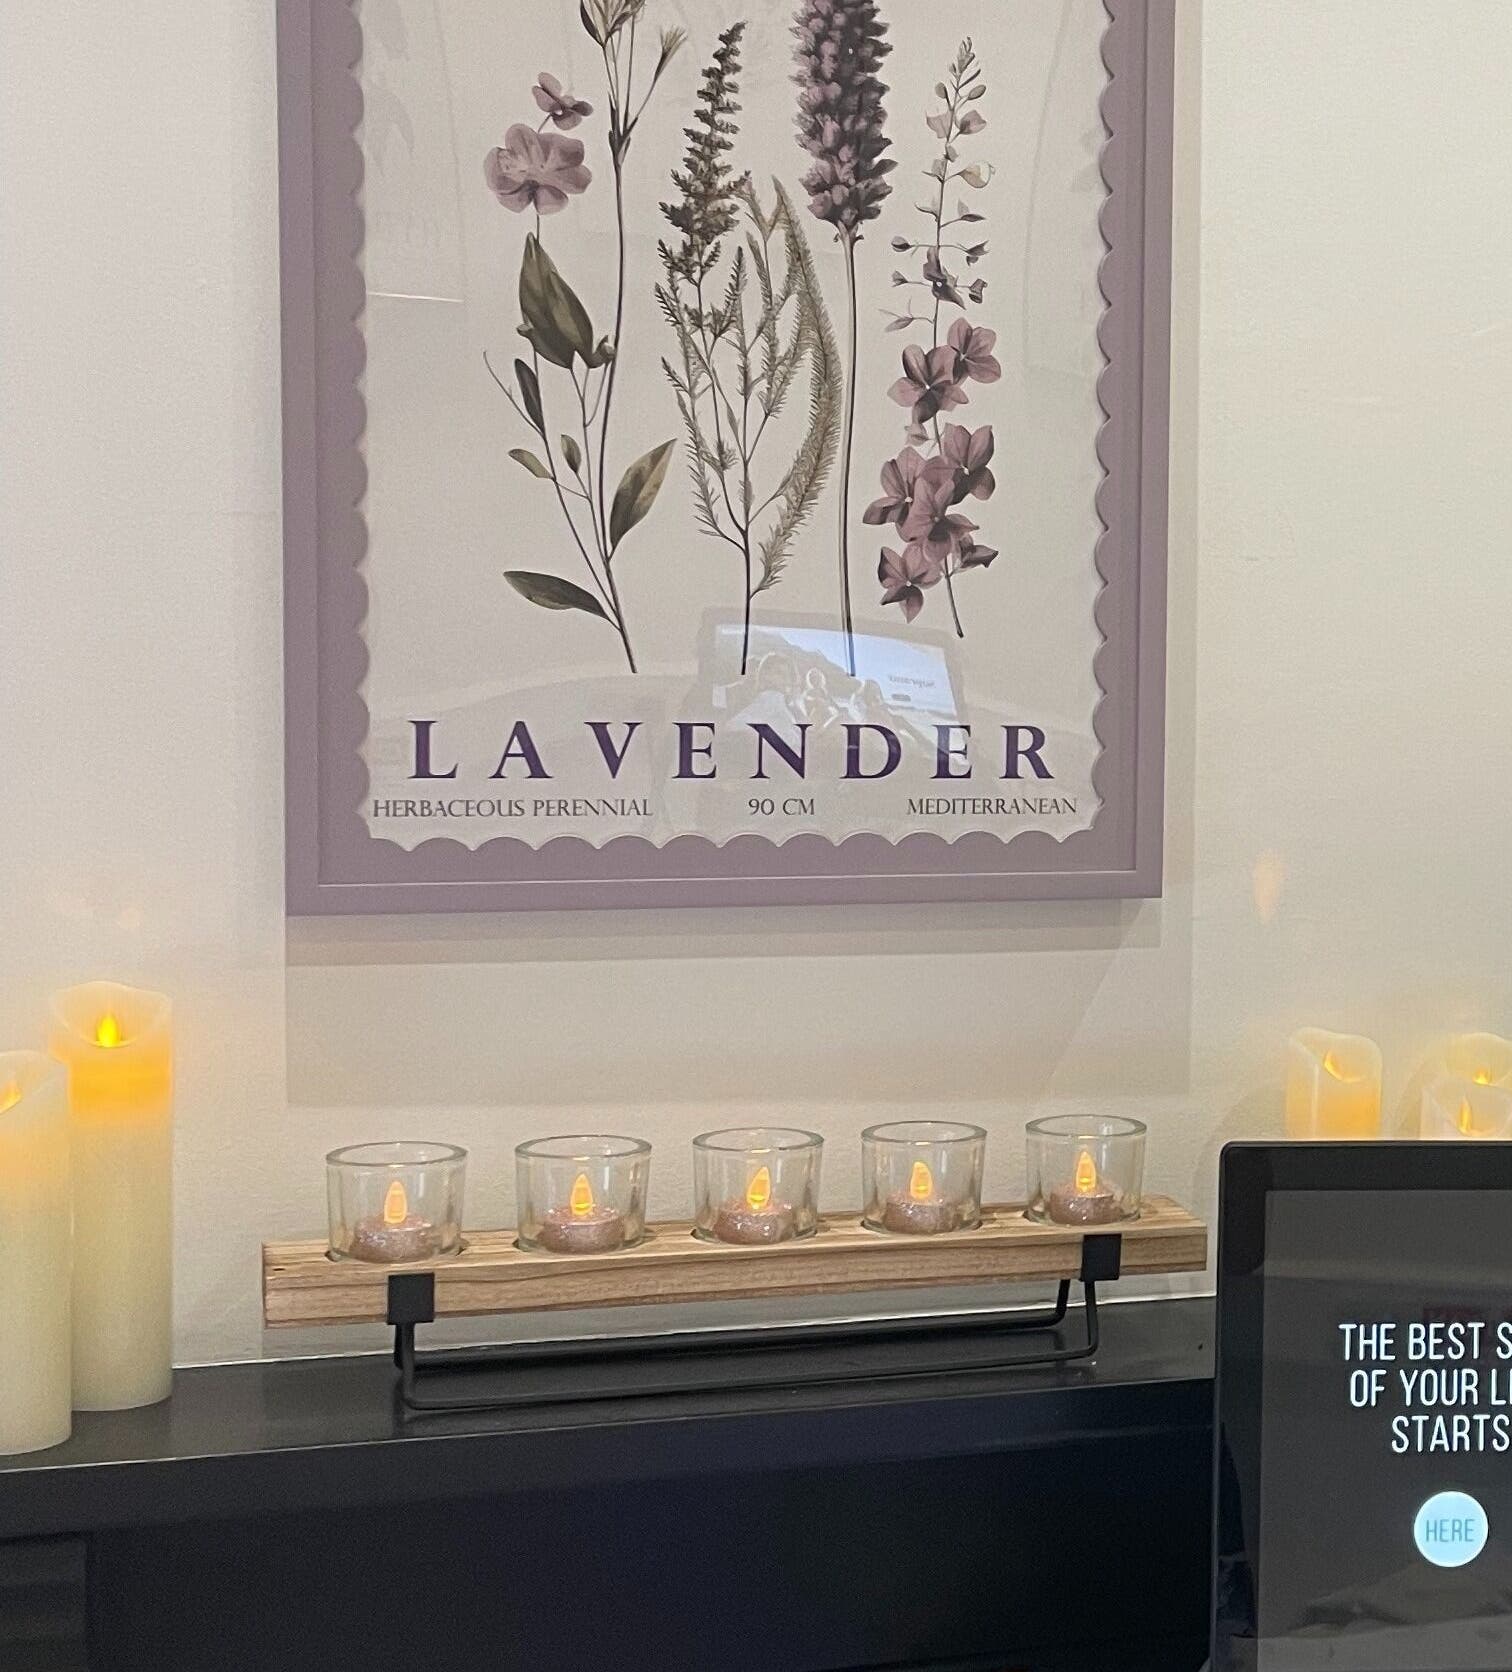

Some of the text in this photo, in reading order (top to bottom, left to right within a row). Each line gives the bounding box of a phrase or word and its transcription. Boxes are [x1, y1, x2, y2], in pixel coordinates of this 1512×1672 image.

[407, 720, 1056, 781] LAVENDER
[373, 798, 1077, 819] HERBACEOUS PERENNIAL 90 CM MEDITERRANEAN
[1339, 1323, 1396, 1361] THE
[1408, 1322, 1486, 1360] BEST
[1350, 1369, 1387, 1407] OF
[1400, 1368, 1479, 1406] YOUR
[1391, 1414, 1511, 1453] STARTS
[1425, 1518, 1475, 1543] HERE
